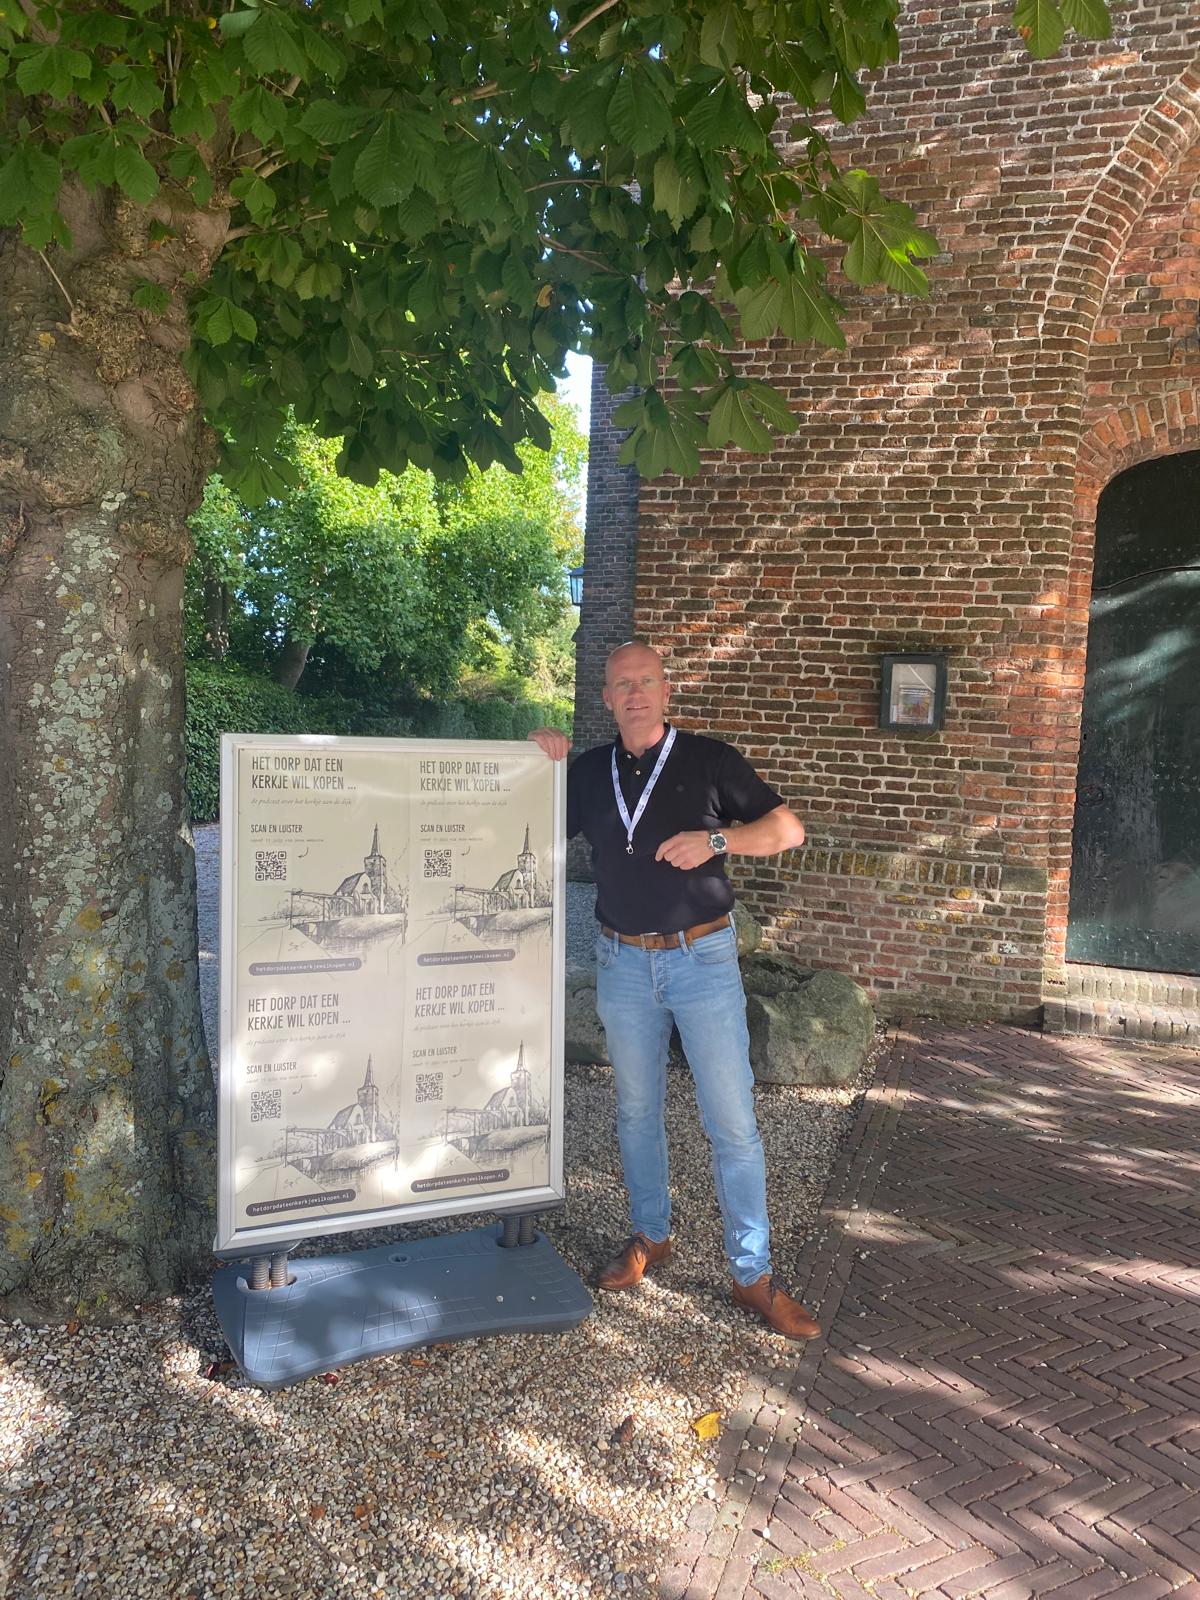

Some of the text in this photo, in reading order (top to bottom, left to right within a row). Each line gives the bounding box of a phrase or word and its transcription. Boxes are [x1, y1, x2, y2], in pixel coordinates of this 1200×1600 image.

[252, 756, 343, 772] HET DORP DAT EEN
[420, 761, 499, 775] HET DORP DAT EEN
[252, 775, 288, 789] KERKJE
[292, 776, 310, 789] WIL
[313, 776, 344, 790] KOPEN
[420, 778, 452, 791] KERKJE
[455, 779, 471, 791] WIL
[473, 779, 500, 792] KOPEN
[251, 825, 303, 833] SCAN EN LUISTER
[416, 982, 495, 1001] HET DORP DAT EEN
[248, 994, 339, 1012] HET DORP DAT EEN
[415, 1002, 446, 1018] KERKJE
[449, 1001, 465, 1015] WIL
[467, 999, 495, 1014] KOPEN
[247, 1015, 284, 1031] KERKJE
[287, 1013, 305, 1028] WIL
[308, 1012, 339, 1026] KOPEN
[412, 1050, 426, 1058] SCAN
[436, 1047, 457, 1055] LUISTER
[246, 1062, 297, 1074] SCAN EN LUISTER
